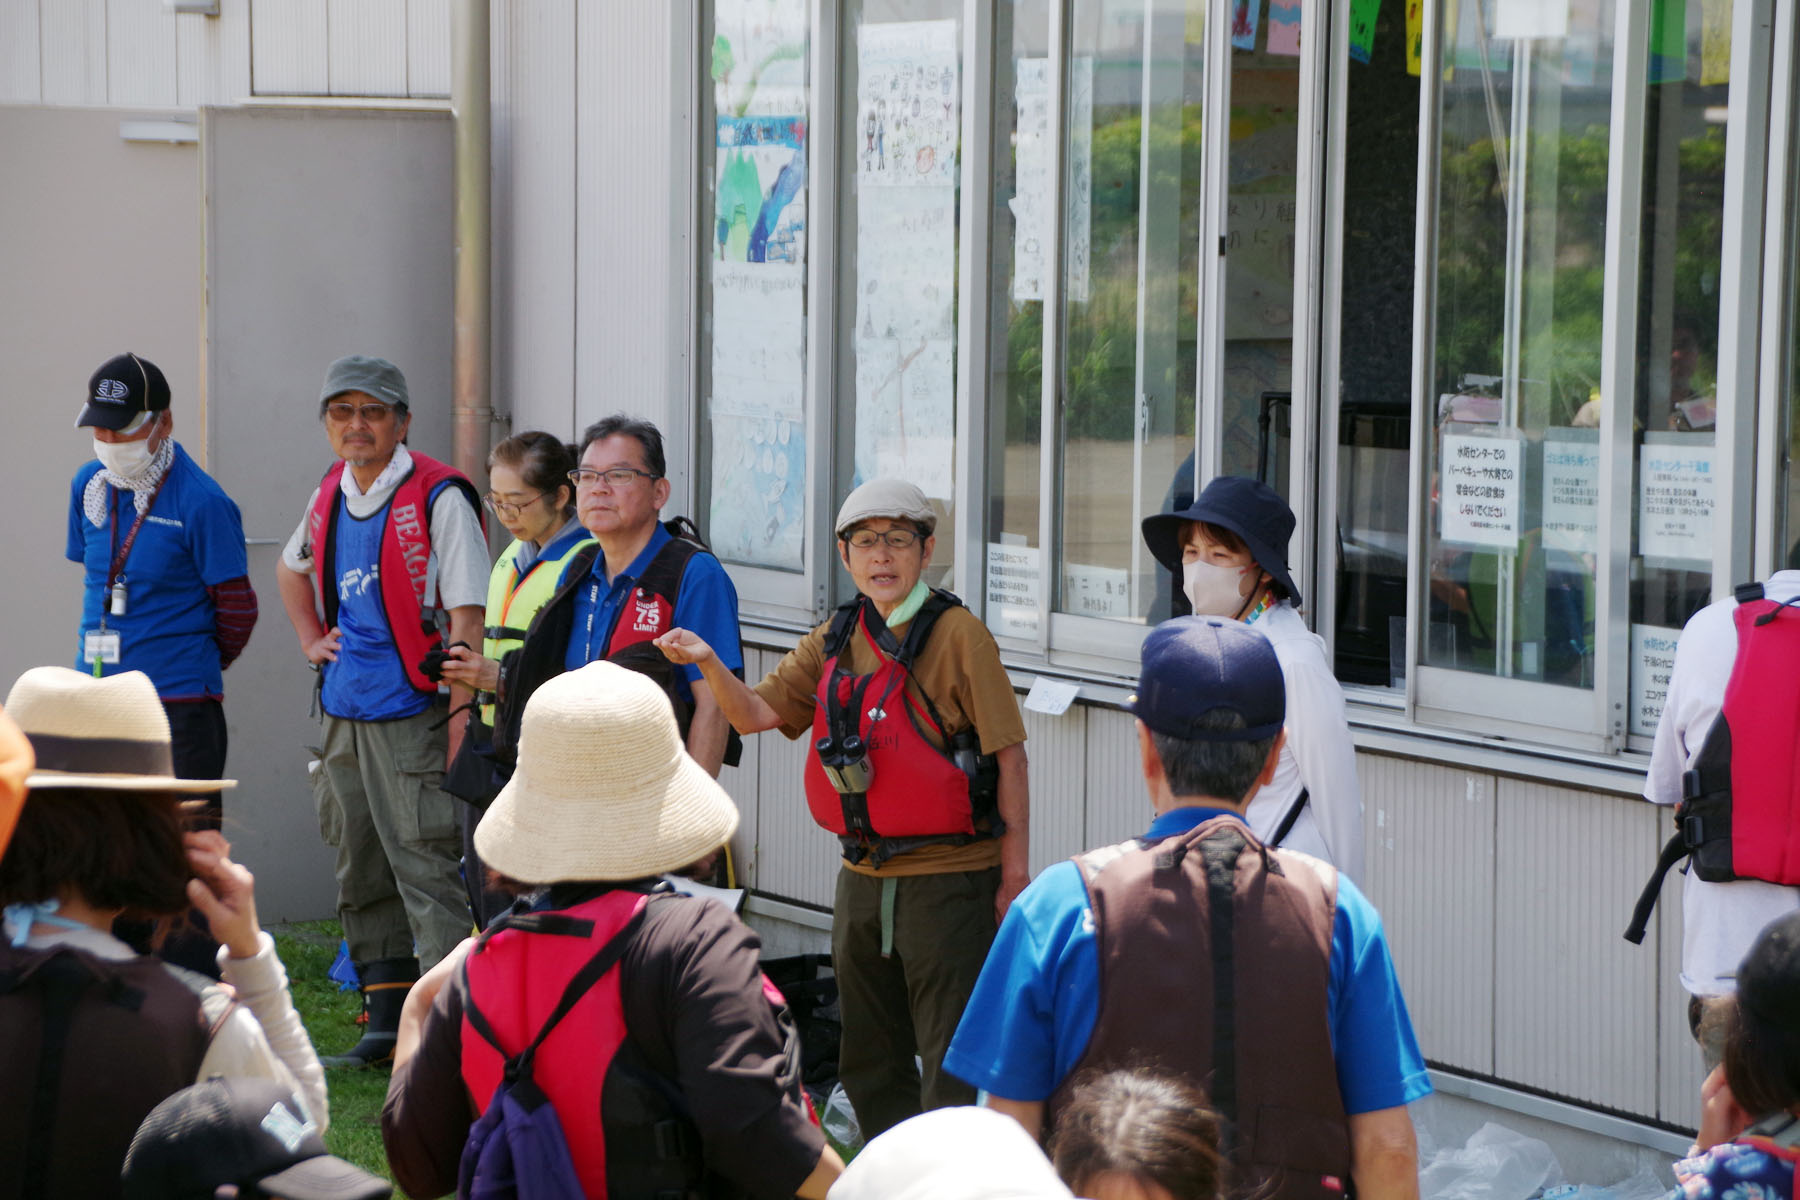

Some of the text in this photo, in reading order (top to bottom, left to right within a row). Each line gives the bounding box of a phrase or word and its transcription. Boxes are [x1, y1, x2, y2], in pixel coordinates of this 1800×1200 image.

[1457, 445, 1506, 460] 水防センターでの
[1459, 503, 1506, 518] しないでください
[635, 599, 659, 609] UNDER
[635, 606, 660, 625] 75
[632, 622, 659, 632] LIMIT
